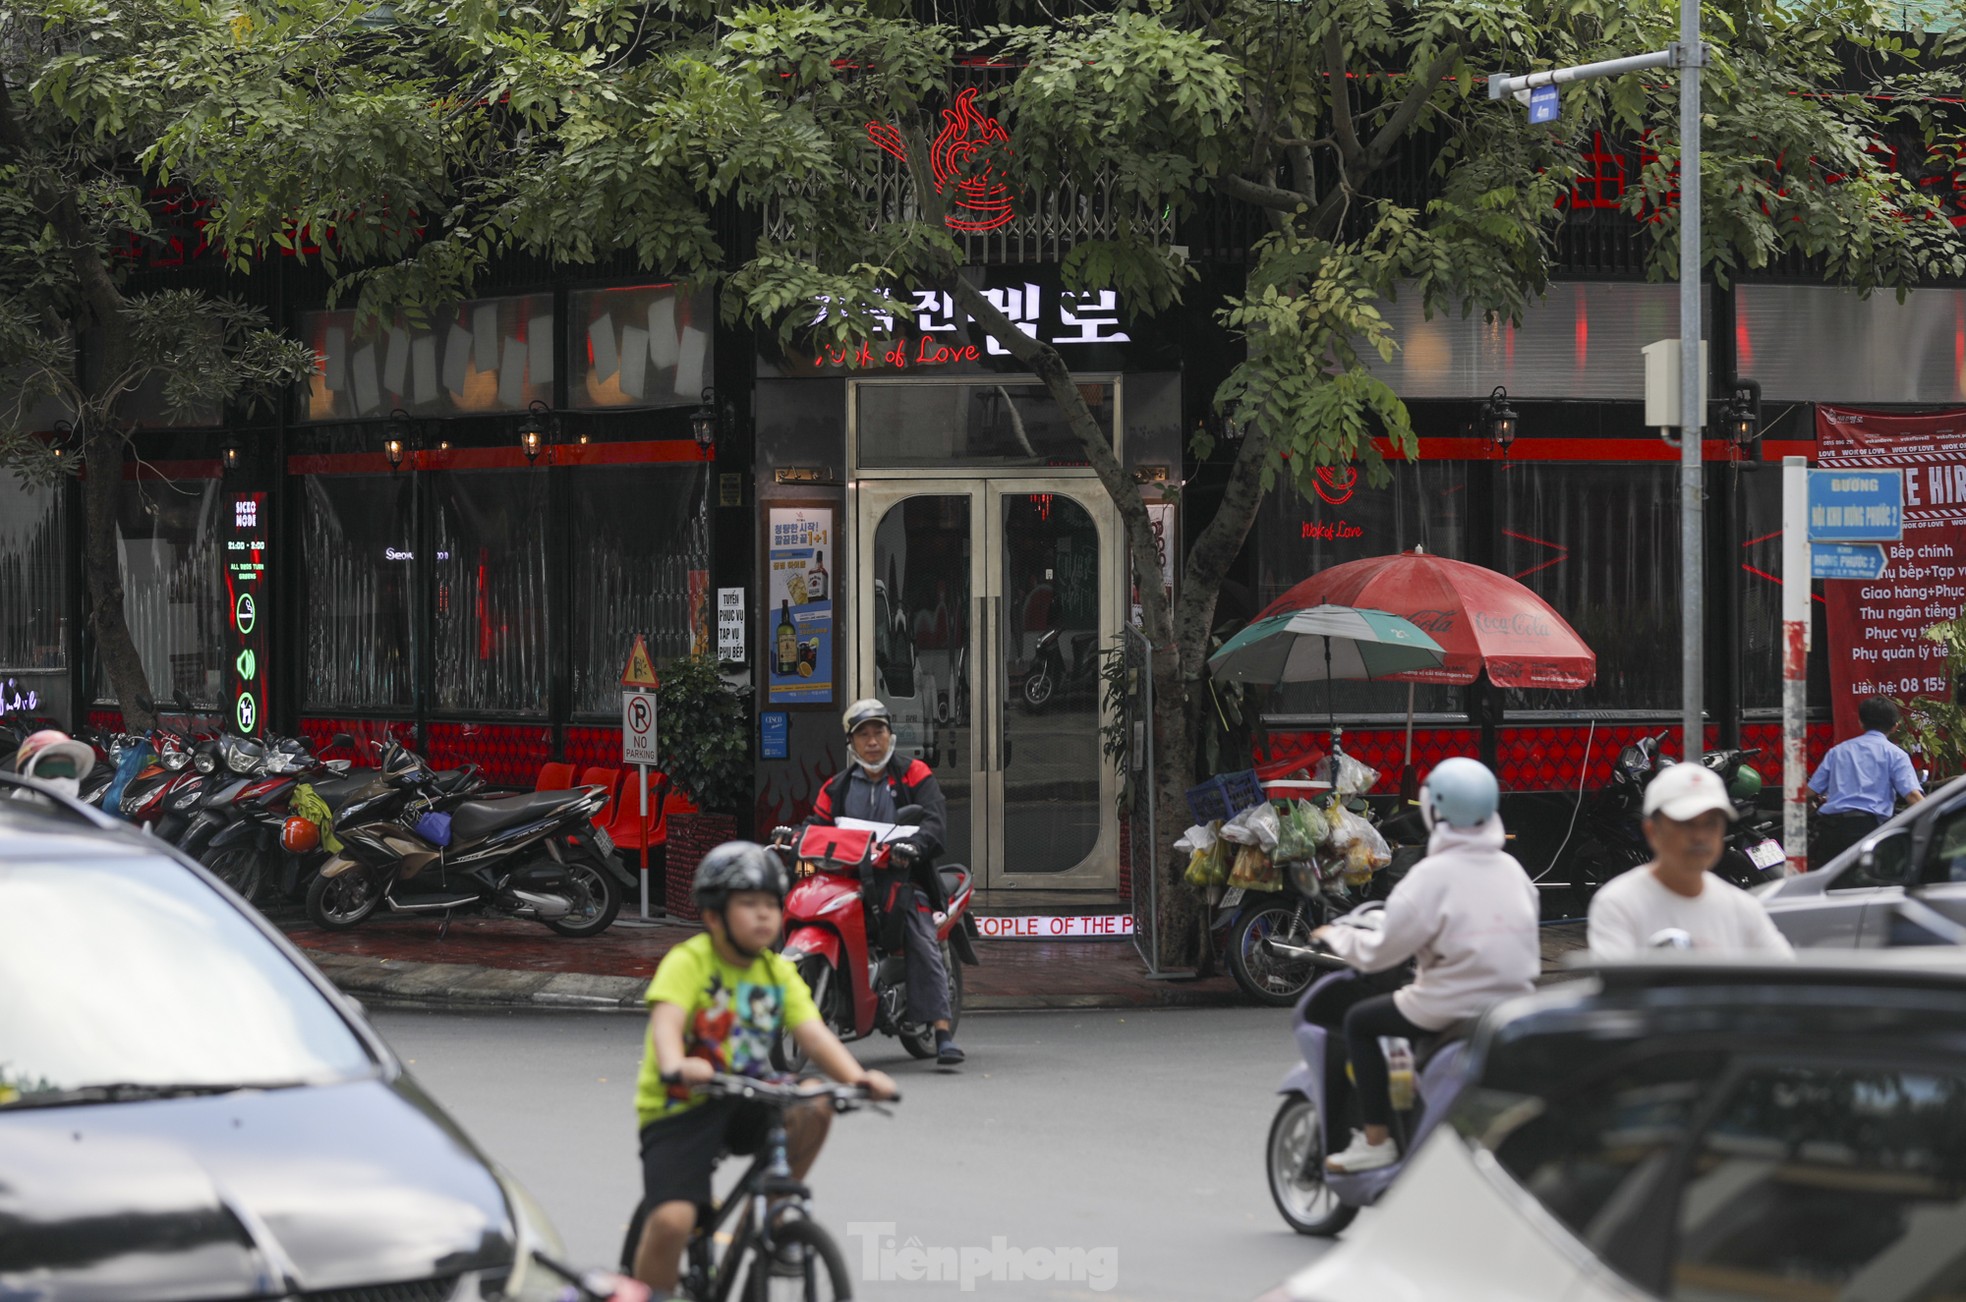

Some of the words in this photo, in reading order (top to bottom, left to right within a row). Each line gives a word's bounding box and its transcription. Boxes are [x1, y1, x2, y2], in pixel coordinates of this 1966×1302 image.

[885, 341, 905, 368] of
[915, 335, 980, 364] Love
[1842, 448, 1859, 456] WOK
[1868, 447, 1886, 455] LOVE
[1918, 444, 1935, 452] LOVE
[1941, 442, 1959, 450] WOK
[1831, 476, 1879, 492] ĐƯỜNG
[235, 501, 257, 514] SICKO
[235, 514, 257, 527] MODE
[1892, 506, 1897, 527] 2
[1302, 520, 1325, 540] Wok
[1324, 522, 1335, 541] of
[1335, 520, 1363, 539] Love
[1918, 521, 1926, 529] OF
[1928, 520, 1944, 528] LOVE
[1890, 542, 1914, 560] Bếp
[1918, 543, 1953, 557] chính
[1869, 556, 1876, 568] 2
[1861, 586, 1891, 599] Giao
[719, 609, 735, 624] PHỤC
[736, 609, 744, 624] VỤ
[1860, 607, 1884, 620] Thu
[1888, 605, 1921, 621] ngân
[1925, 601, 1956, 619] tiếng
[719, 628, 731, 643] TẠP
[731, 628, 740, 643] VỤ
[1865, 626, 1898, 643] Phục
[1901, 628, 1917, 642] vụ
[732, 643, 744, 658] BẾP
[1852, 648, 1878, 663] Phụ
[1882, 646, 1915, 661] quản
[1919, 643, 1930, 660] lý
[1932, 642, 1949, 657] tiế
[1852, 682, 1875, 695] Liên
[1900, 678, 1919, 692] 08
[634, 735, 648, 749] NO
[626, 748, 655, 760] PARKING
[975, 918, 1039, 936] EOPLE
[1050, 918, 1075, 935] OF
[1081, 917, 1116, 934] THE
